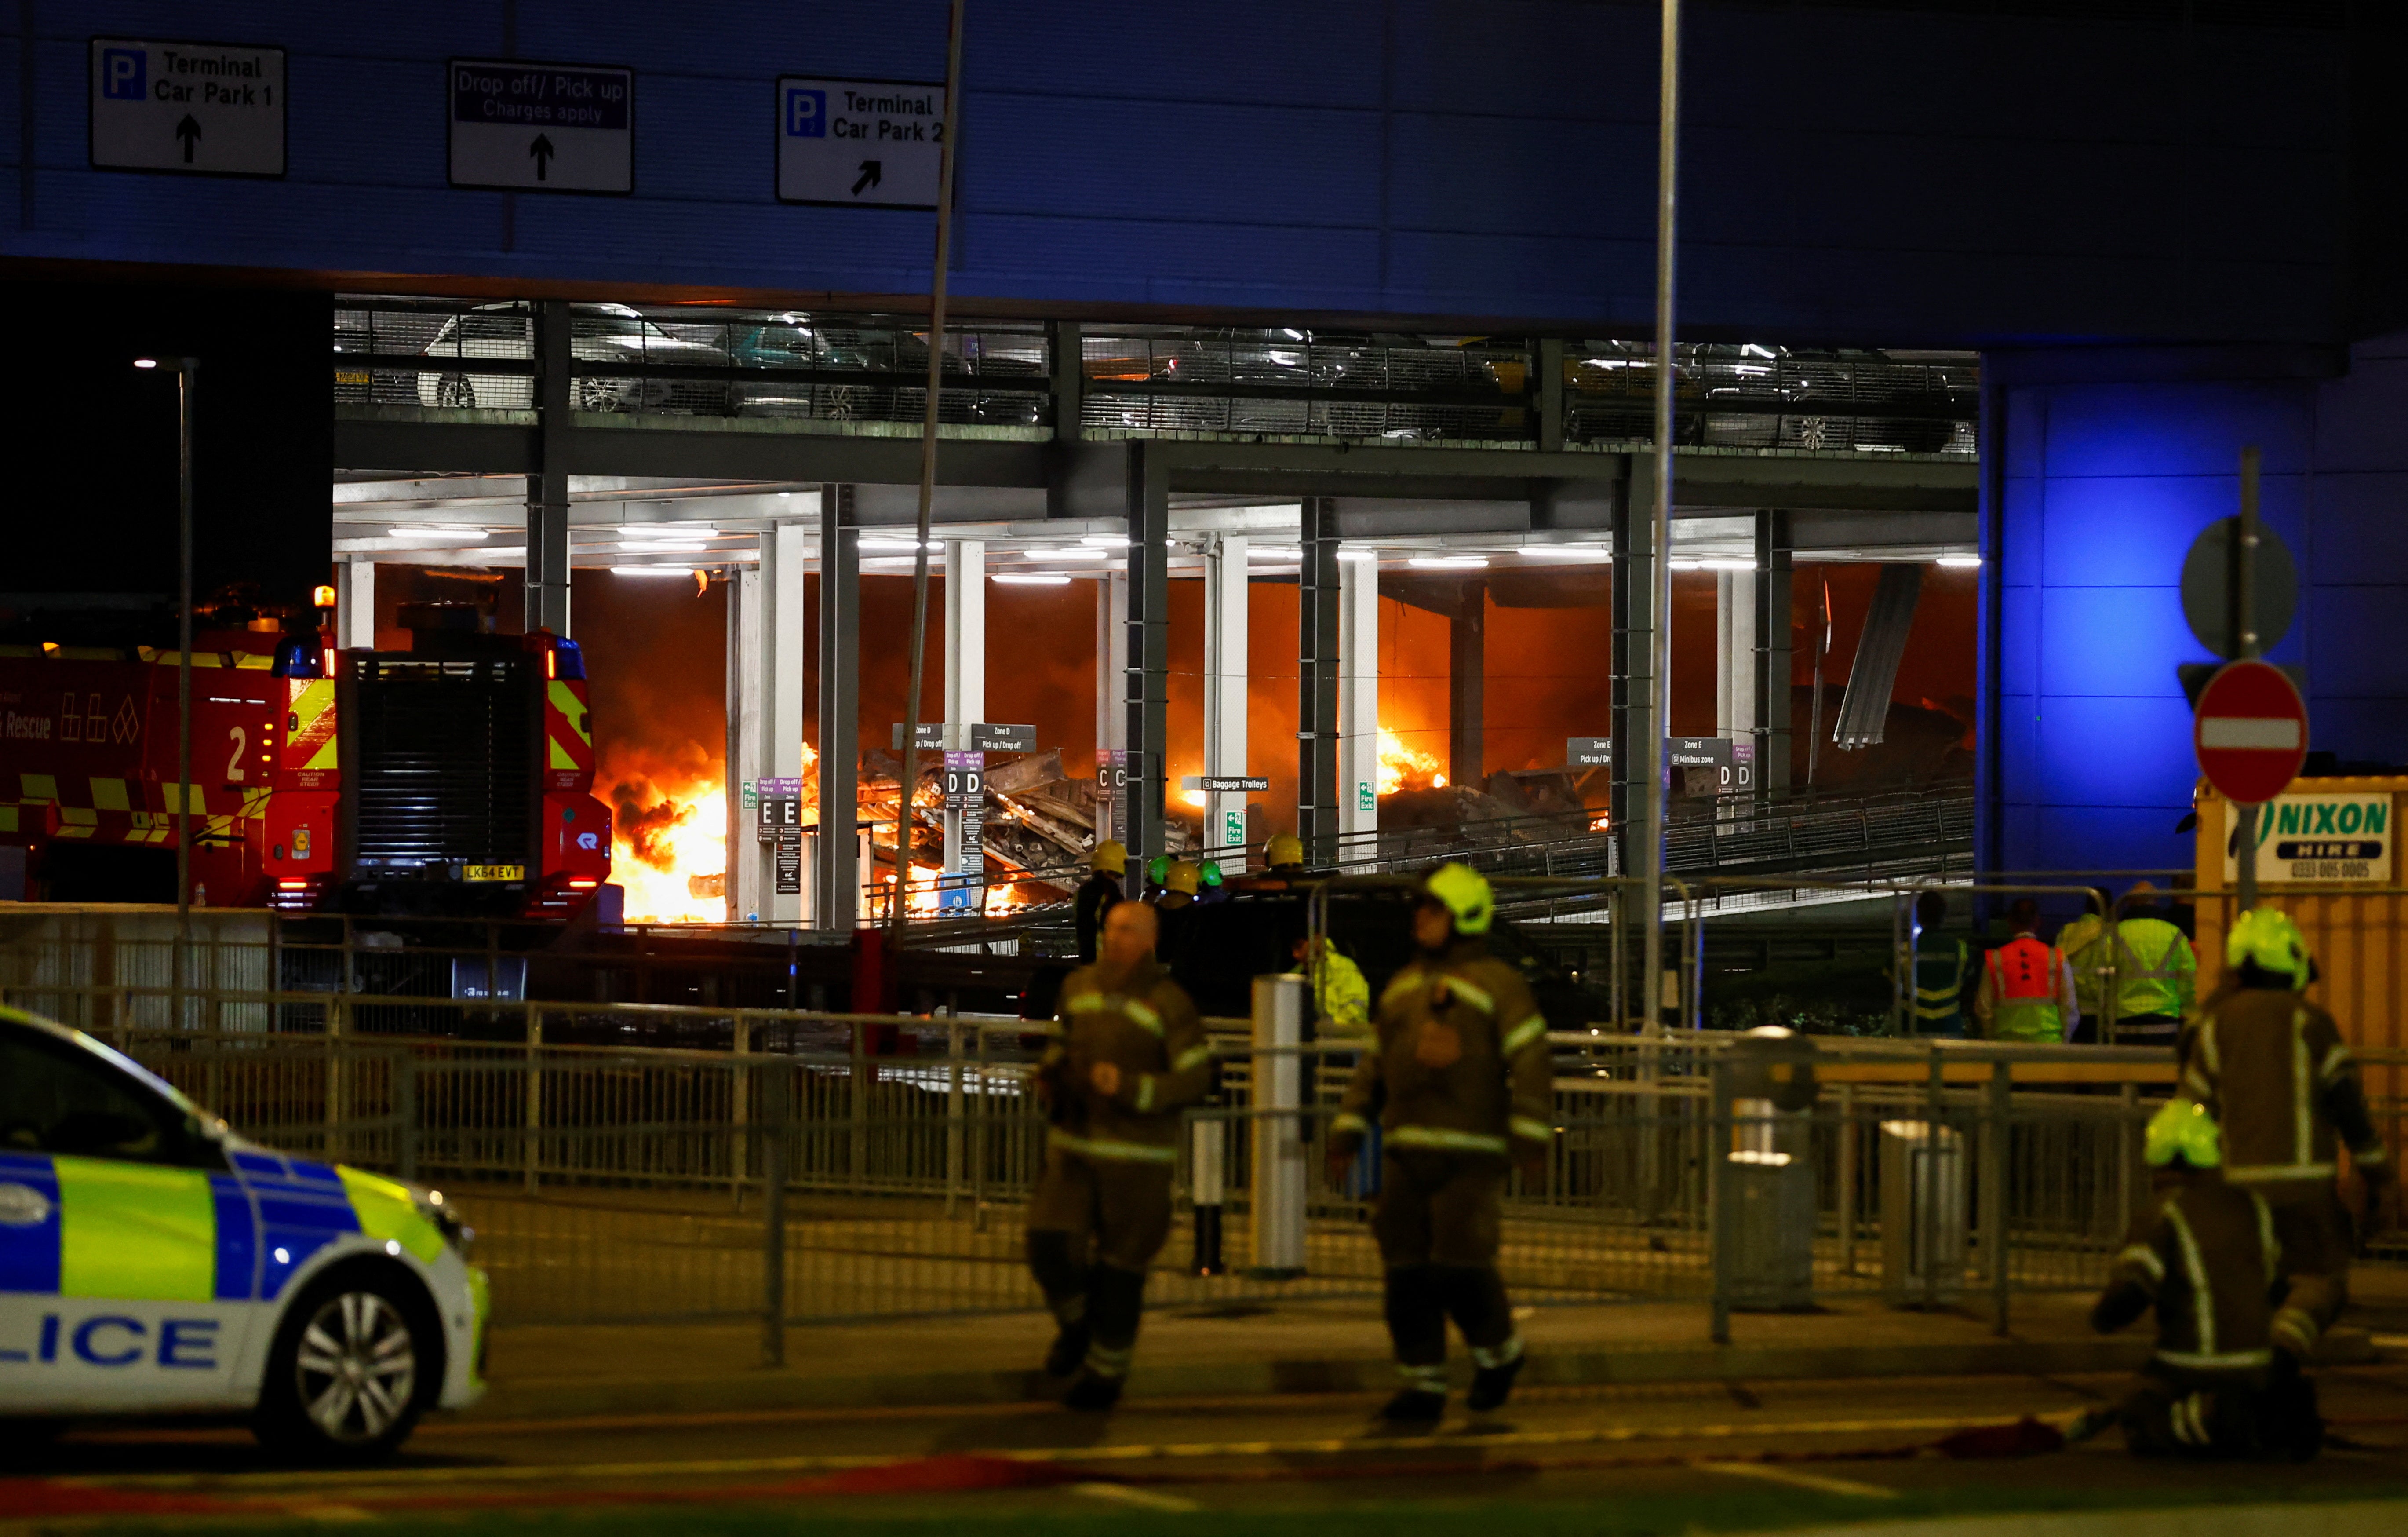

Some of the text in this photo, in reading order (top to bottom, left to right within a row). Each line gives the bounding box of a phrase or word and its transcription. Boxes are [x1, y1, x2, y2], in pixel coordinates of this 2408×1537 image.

[164, 52, 262, 77] Terminal
[155, 79, 271, 106] Car Park 1
[459, 70, 503, 96] Drop
[556, 76, 594, 98] Pick
[601, 84, 623, 104] up
[484, 99, 603, 125] Charges apply
[844, 91, 933, 115] Terminal
[793, 95, 816, 132] P
[833, 117, 943, 142] Car Park 2
[6, 710, 51, 739] Rescue
[227, 726, 245, 780] 2
[924, 740, 934, 749] Drop
[1002, 741, 1013, 750] Drop
[1580, 755, 1591, 763] Pick
[1592, 756, 1599, 765] up
[1680, 755, 1700, 763] Minibus
[949, 774, 958, 792] D
[967, 773, 979, 793] D
[1100, 769, 1107, 787] C
[1116, 769, 1125, 787] C
[1212, 780, 1267, 790] Baggage Trolleys
[1721, 766, 1730, 785] D
[1738, 766, 1749, 785] D
[763, 803, 771, 823] E
[785, 802, 795, 824] E
[2278, 802, 2387, 834] NIXON
[467, 866, 519, 877] LK64 EVT
